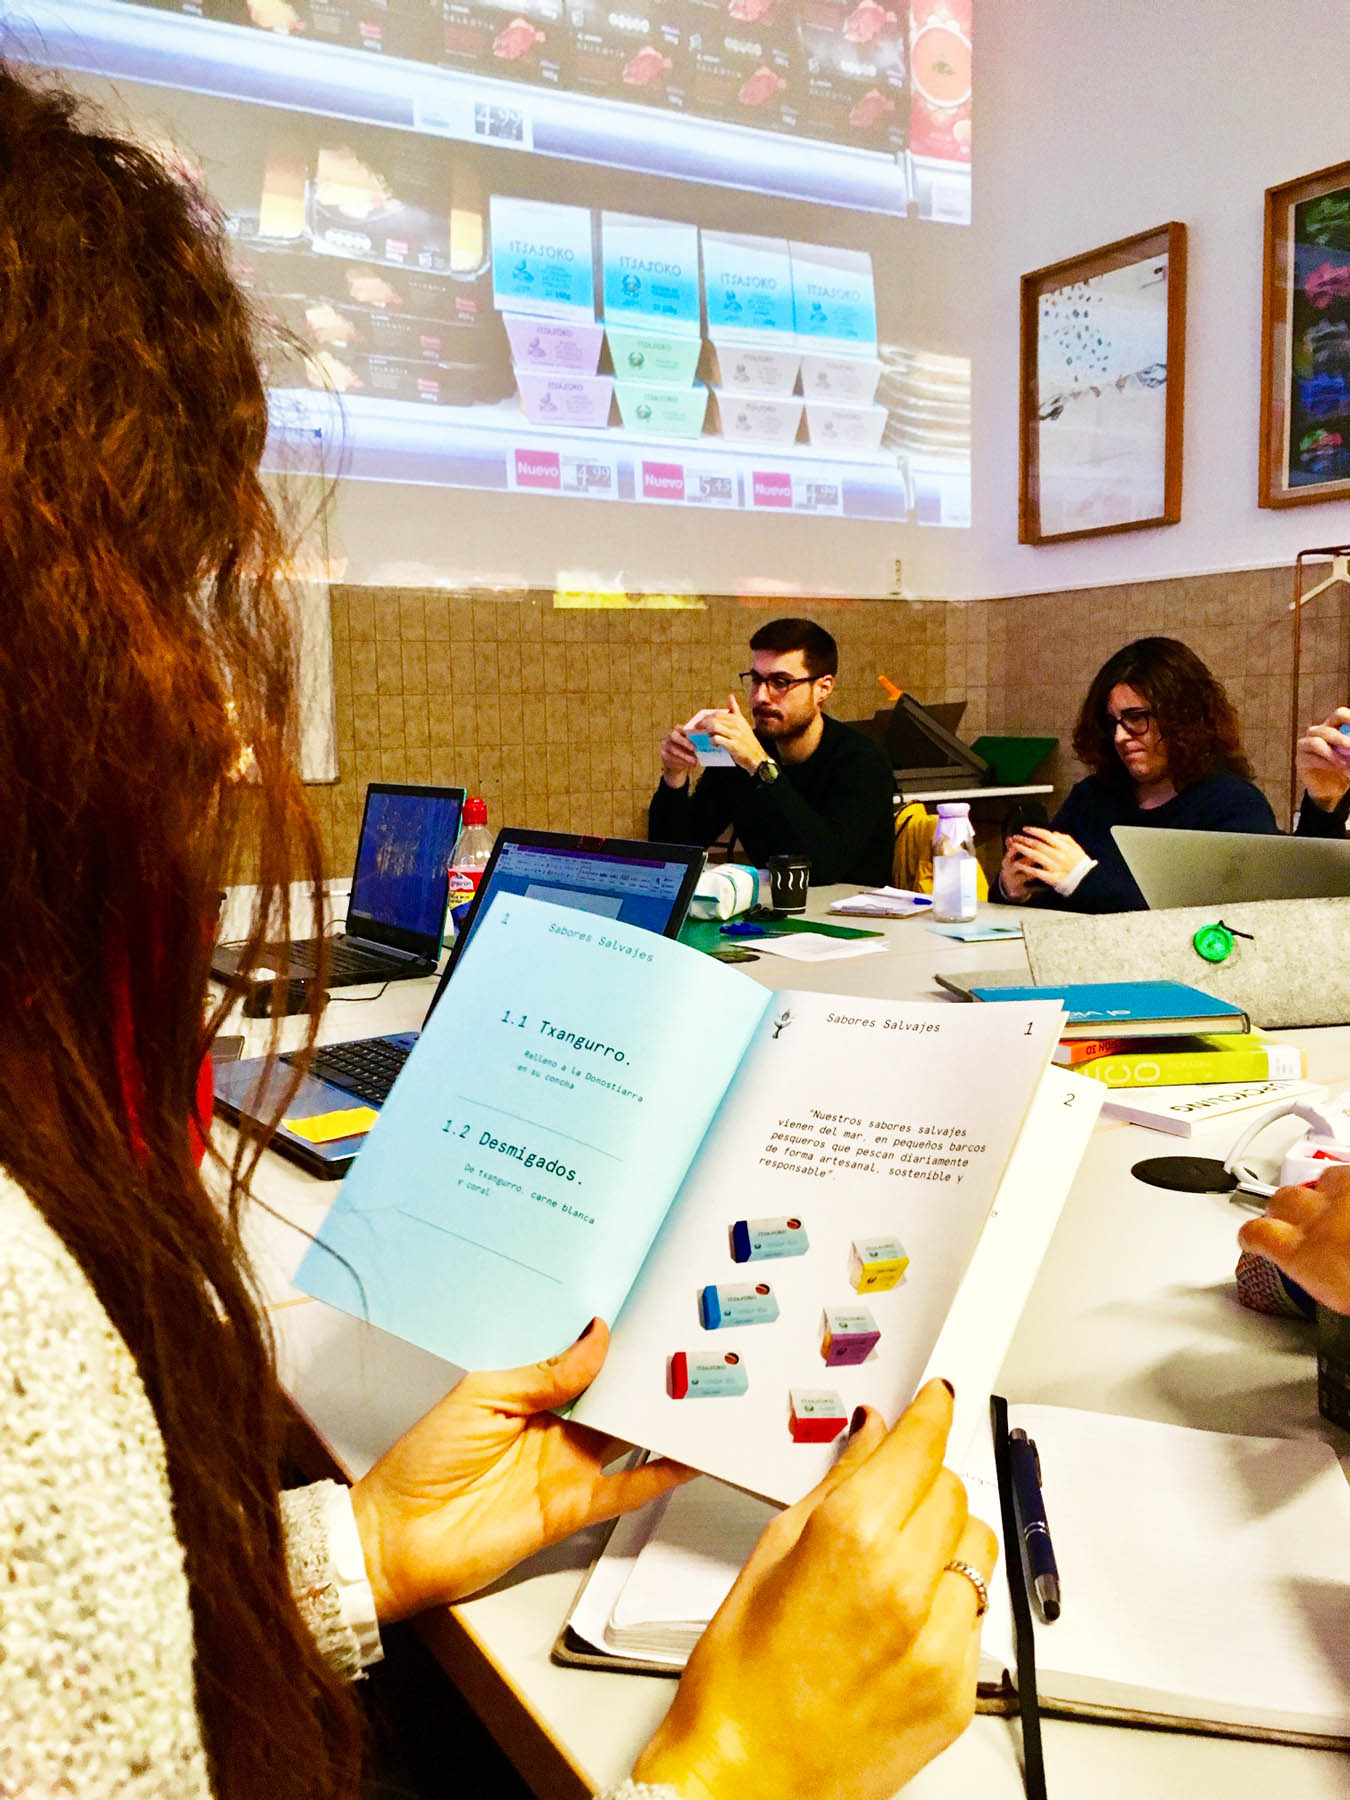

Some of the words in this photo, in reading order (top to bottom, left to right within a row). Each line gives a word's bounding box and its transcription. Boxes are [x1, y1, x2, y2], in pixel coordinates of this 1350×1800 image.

[518, 461, 559, 478] Nuevo
[644, 474, 683, 489] Nuevo
[754, 483, 790, 496] Nuevo
[548, 922, 591, 942] Sabores
[598, 936, 654, 962] Salvajes
[501, 1010, 528, 1028] 1.1
[540, 1020, 631, 1066] Txangurro.
[826, 1013, 876, 1029] Sabores
[884, 1019, 941, 1034] Salvajes
[1024, 1021, 1034, 1035] 1
[517, 1064, 528, 1072] en
[531, 1069, 541, 1078] su
[545, 1073, 575, 1090] concha
[524, 1050, 558, 1068] Relleno
[571, 1066, 582, 1077] la
[585, 1072, 643, 1102] Donostiarra
[1064, 1092, 1076, 1107] 2
[778, 1118, 814, 1132] vienen
[819, 1122, 837, 1136] del
[874, 1134, 888, 1144] en
[893, 1137, 944, 1156] pequeños
[949, 1139, 986, 1153] barcos
[868, 1118, 911, 1133] sabores
[918, 1122, 967, 1138] salvajes
[442, 1119, 471, 1139] 1.2
[479, 1131, 583, 1185] Desmigados.
[765, 1143, 778, 1154] de
[783, 1146, 814, 1162] forma
[888, 1165, 951, 1182] sostenible
[957, 1174, 964, 1184] y
[771, 1131, 826, 1152] pesqueros
[831, 1142, 851, 1157] que
[856, 1146, 895, 1163] pescan
[900, 1150, 969, 1168] diariamente
[464, 1163, 475, 1173] De
[530, 1191, 558, 1208] carne
[561, 1204, 595, 1225] blanca
